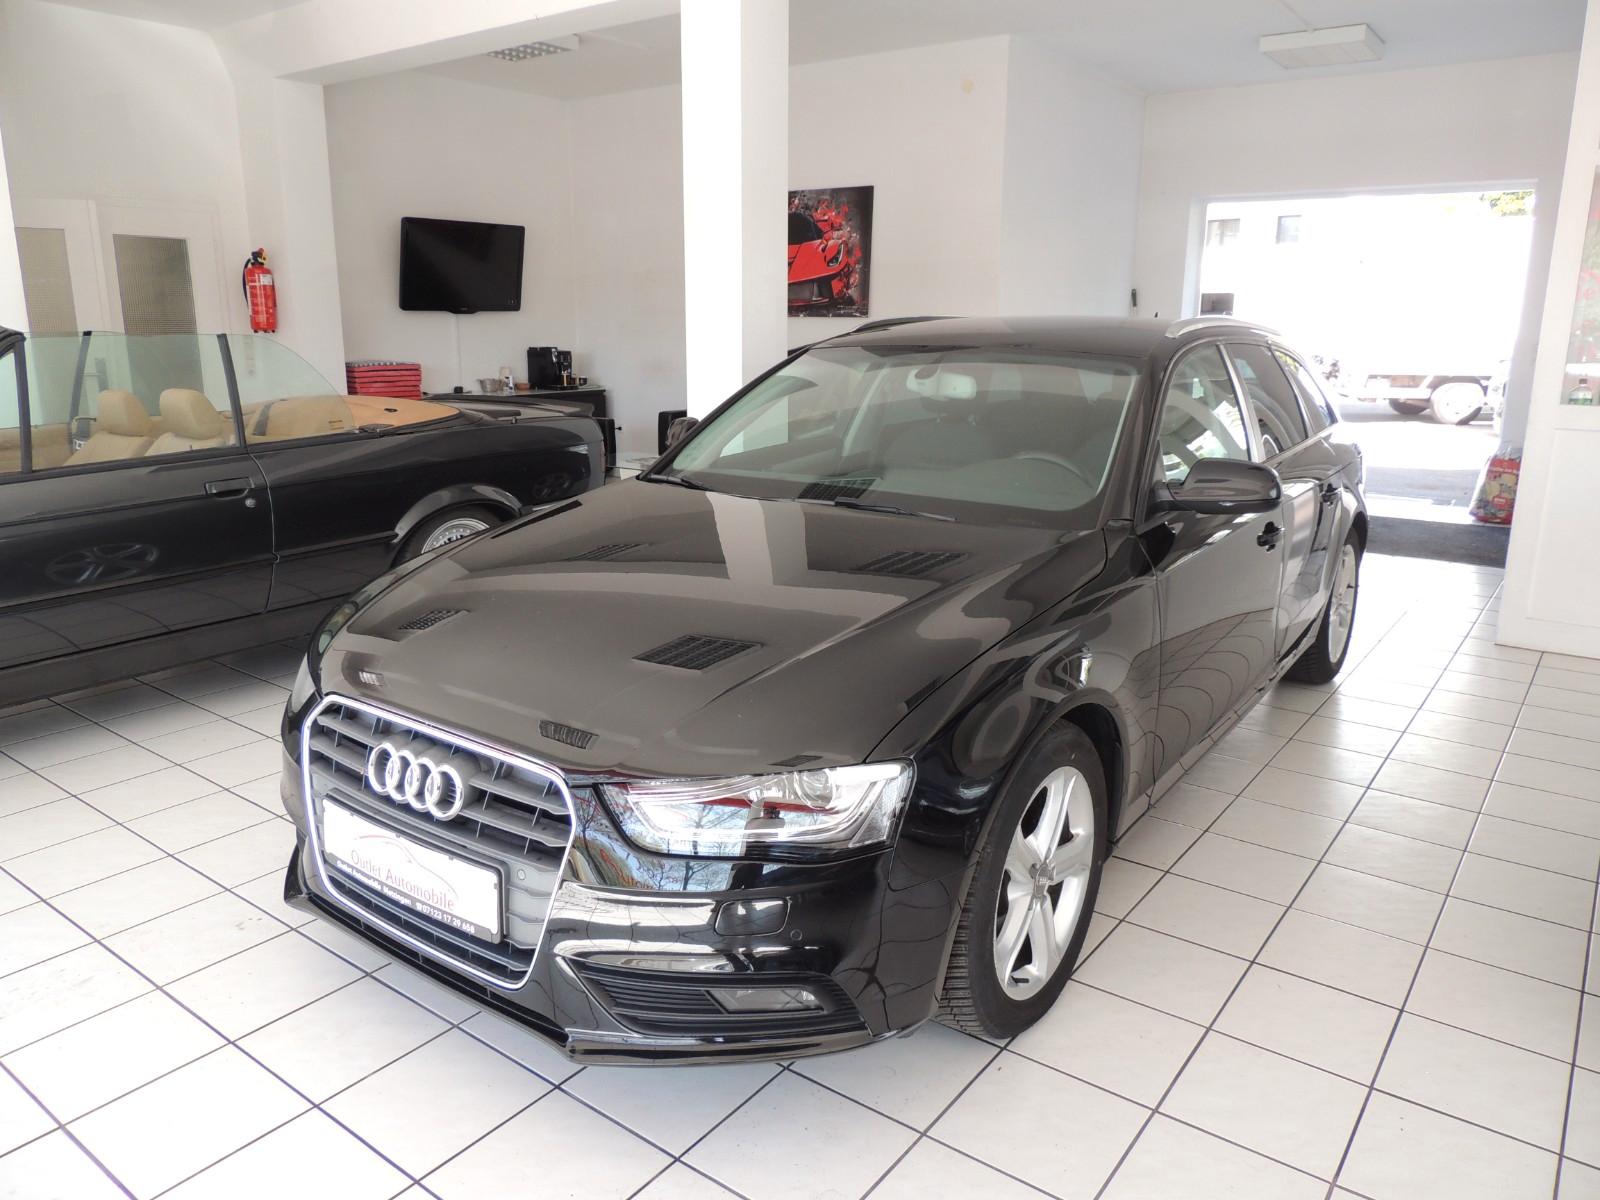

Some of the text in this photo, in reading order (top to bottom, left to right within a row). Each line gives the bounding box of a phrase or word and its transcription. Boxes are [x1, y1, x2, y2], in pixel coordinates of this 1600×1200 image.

[351, 849, 456, 911] Outlet Automobile
[443, 913, 452, 923] 17
[452, 918, 461, 928] 29
